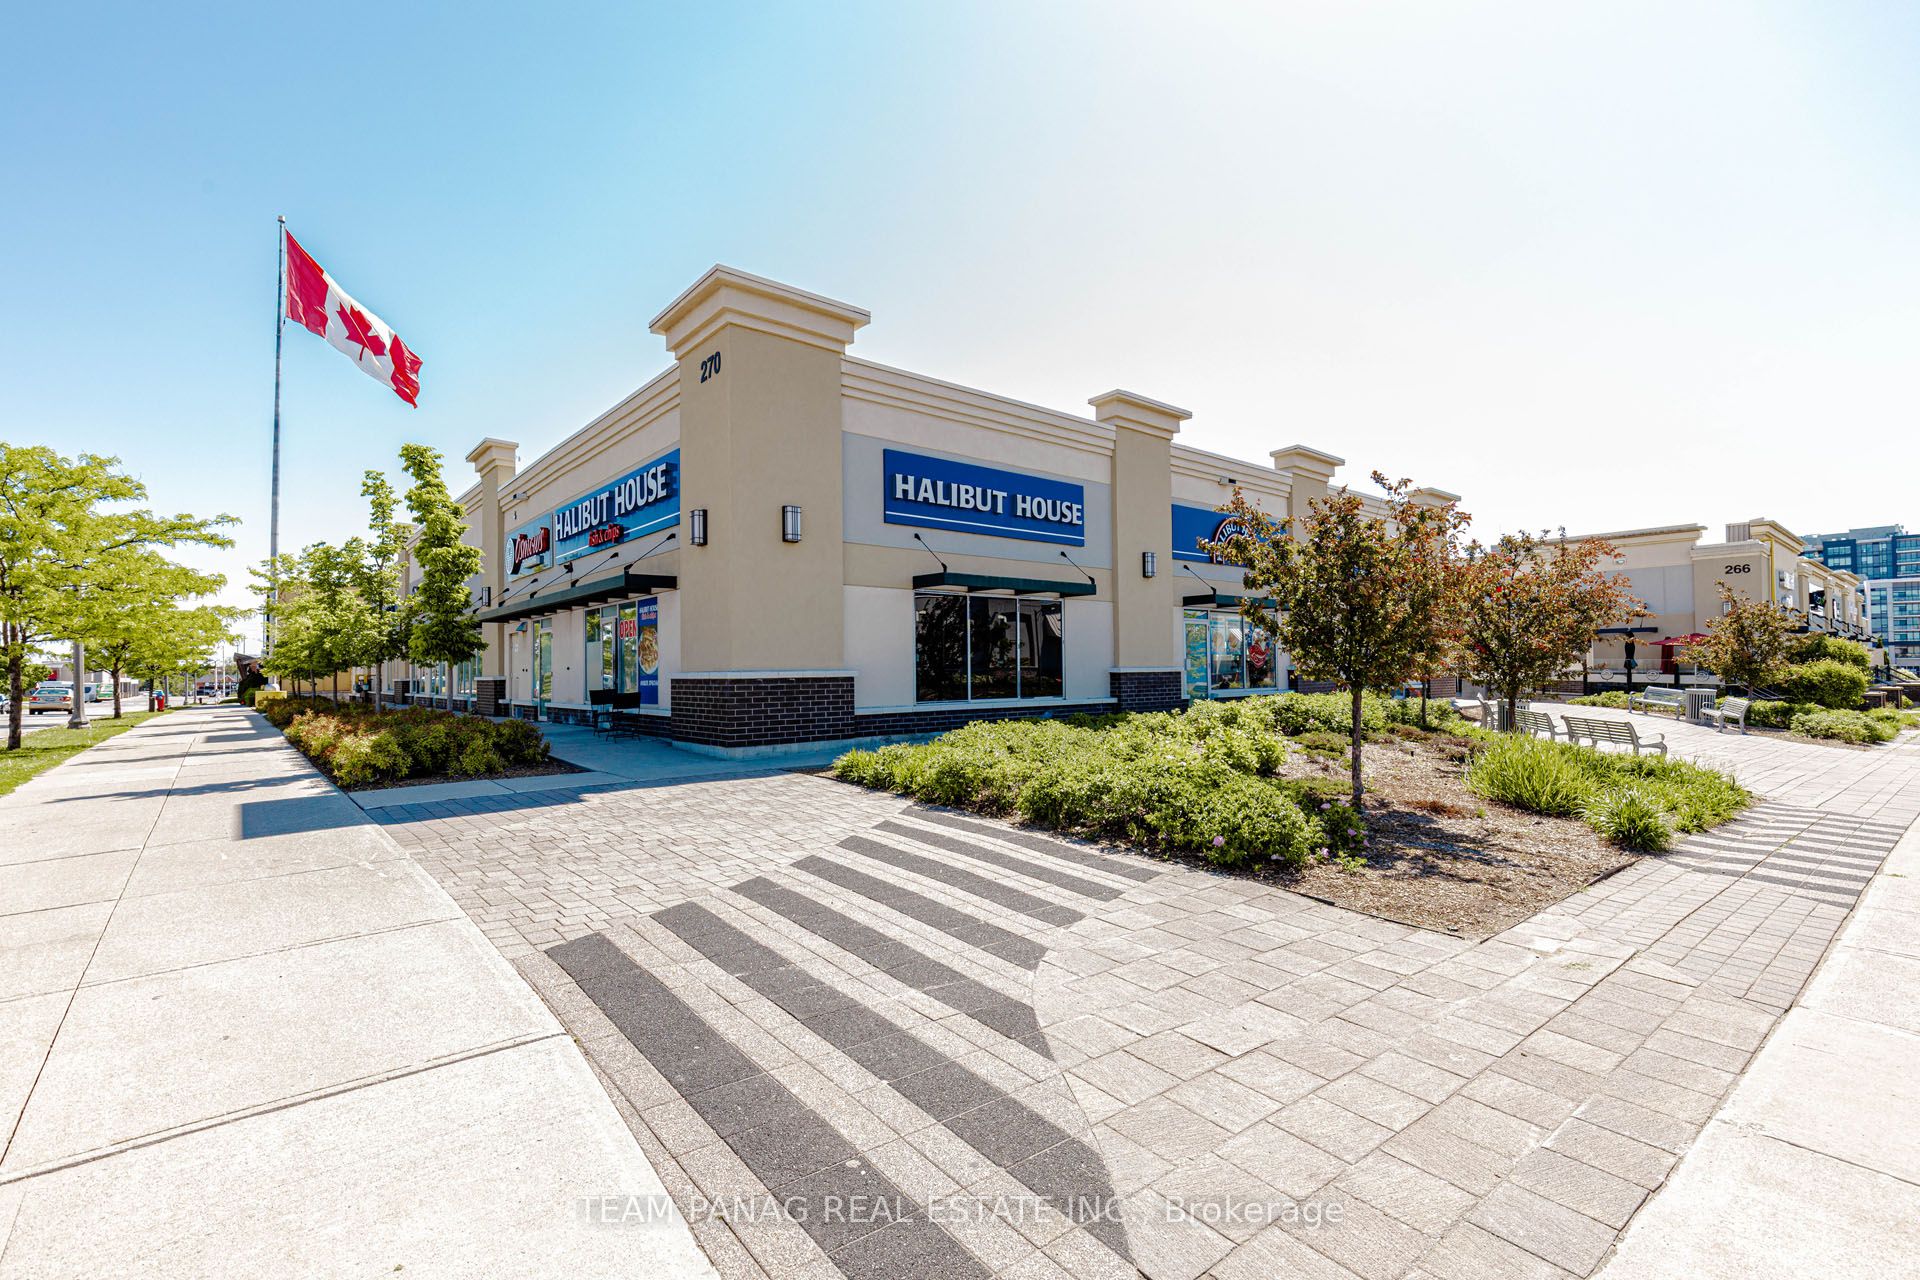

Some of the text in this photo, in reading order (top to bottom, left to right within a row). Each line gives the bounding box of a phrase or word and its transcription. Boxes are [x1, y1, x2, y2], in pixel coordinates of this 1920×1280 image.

[700, 351, 721, 383] 270
[555, 463, 667, 541] HALIBUT HOUSE
[895, 473, 1083, 525] HALIBUT HOUSE
[1725, 563, 1751, 575] 266
[619, 619, 637, 639] OPEN
